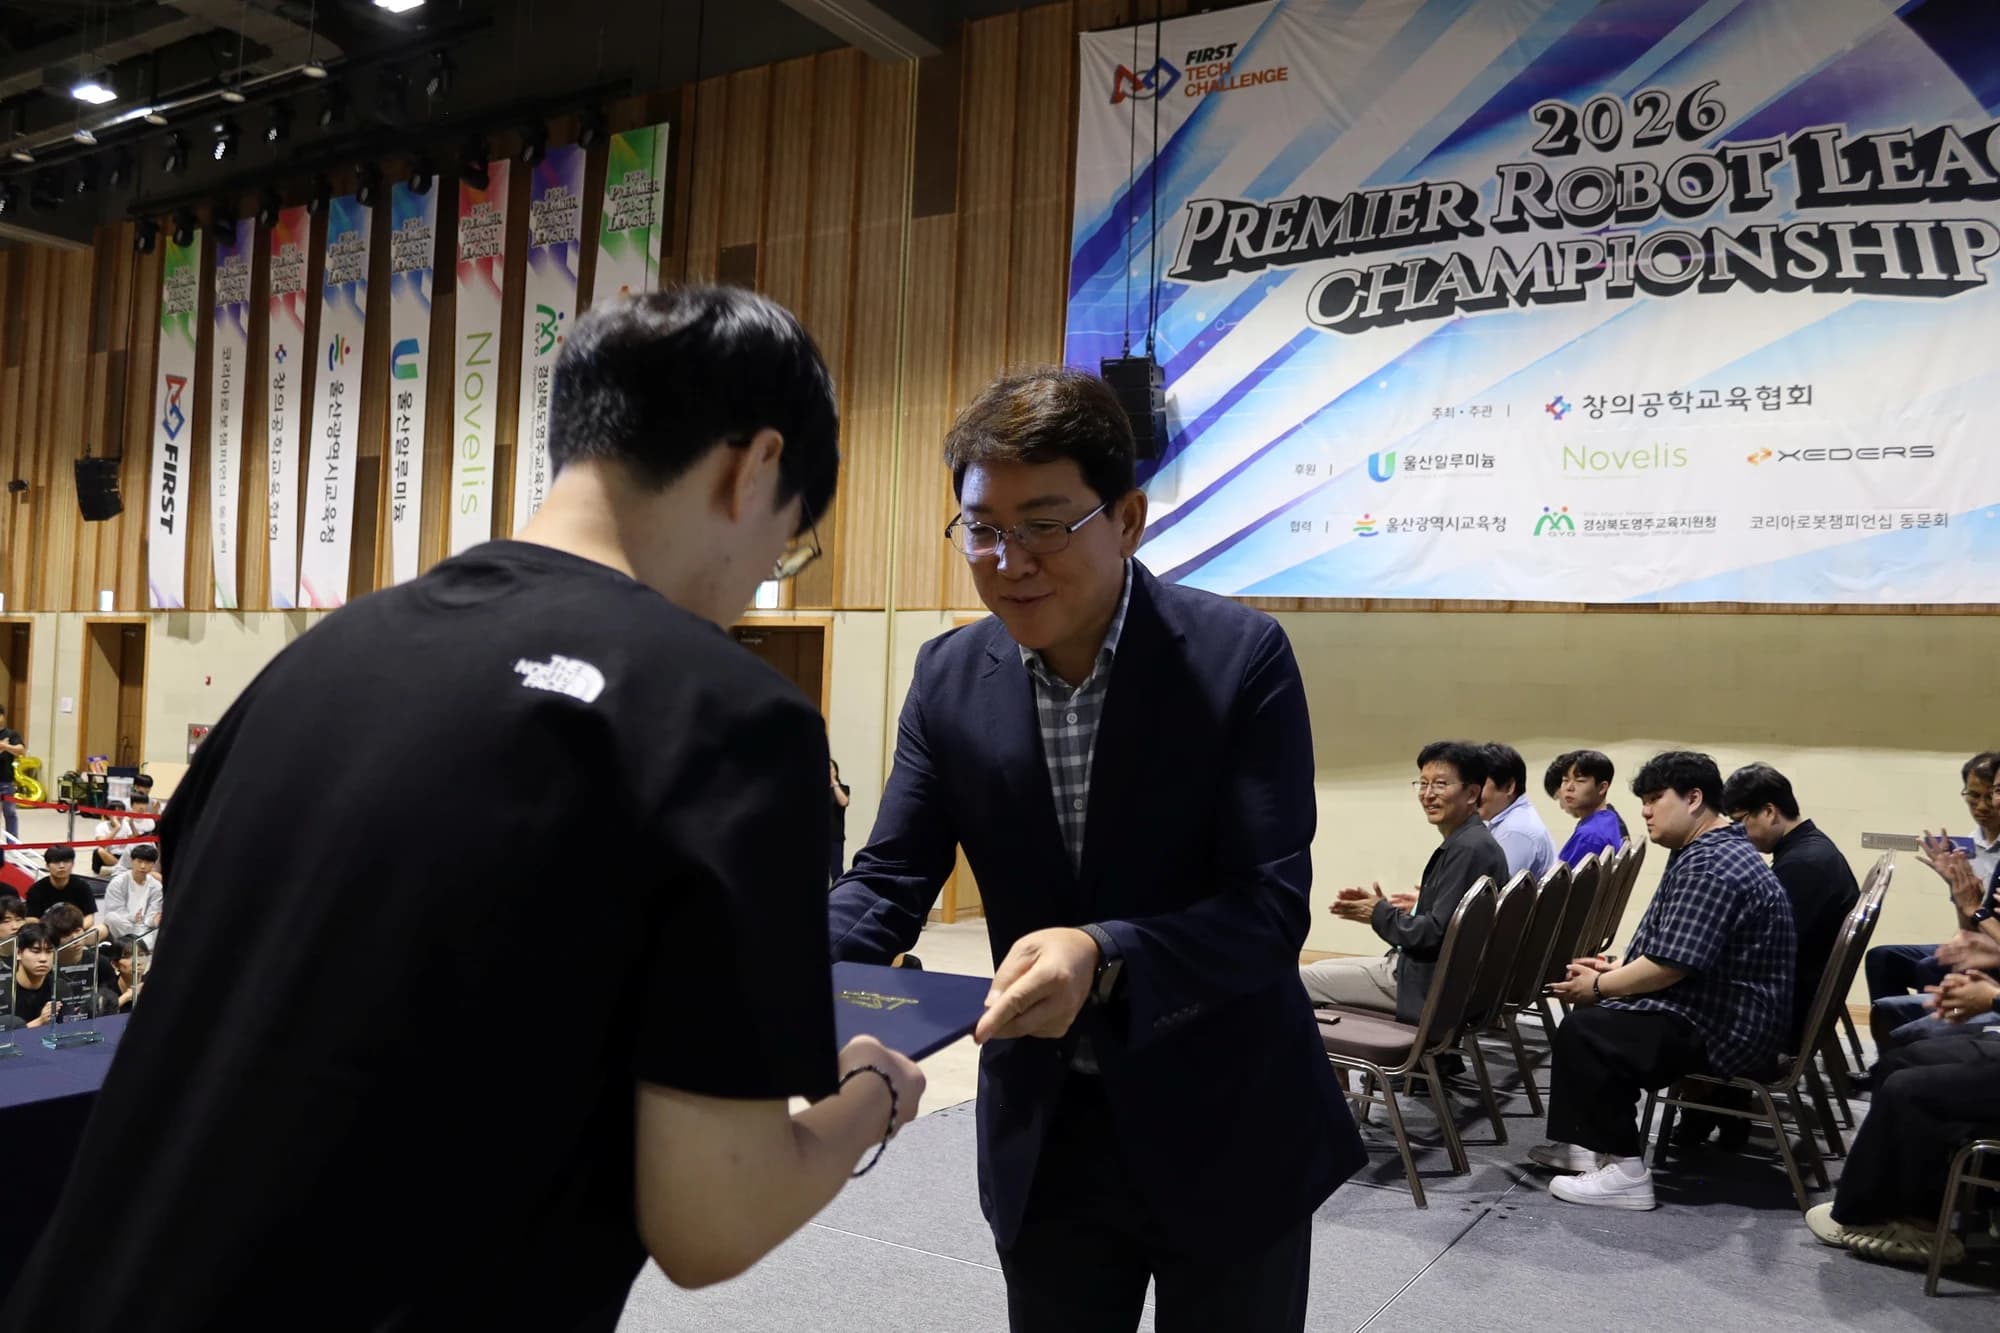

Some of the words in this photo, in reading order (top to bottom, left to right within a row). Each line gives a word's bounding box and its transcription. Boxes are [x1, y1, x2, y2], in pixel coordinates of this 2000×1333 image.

[1185, 42, 1238, 66] FIRST
[1183, 66, 1289, 97] CHALLENGE
[1185, 61, 1232, 81] TECH
[1531, 80, 1727, 157] 2026
[1168, 181, 1485, 282] PREMIER
[1491, 138, 1783, 233] ROBOT
[1796, 122, 2000, 209] LEA
[1306, 219, 2000, 334] CHAMPIONSHIP
[1582, 384, 1813, 420] 창의공학교육협회
[461, 332, 493, 515] Novelis
[320, 379, 345, 543] 울산광역시교육청
[393, 390, 413, 521] 울산알루미늄
[1403, 453, 1496, 471] 울산알루미늄
[1563, 442, 1688, 471] Novelis
[1777, 445, 1935, 462] XEDERS
[160, 443, 178, 535] FIRST
[1386, 515, 1507, 534] 울산광역시교육청
[1583, 515, 1717, 532] 경상북도영주교육지원청
[1750, 514, 1893, 531] 코리아로봇챔피언십
[1900, 513, 1949, 530] 동문회
